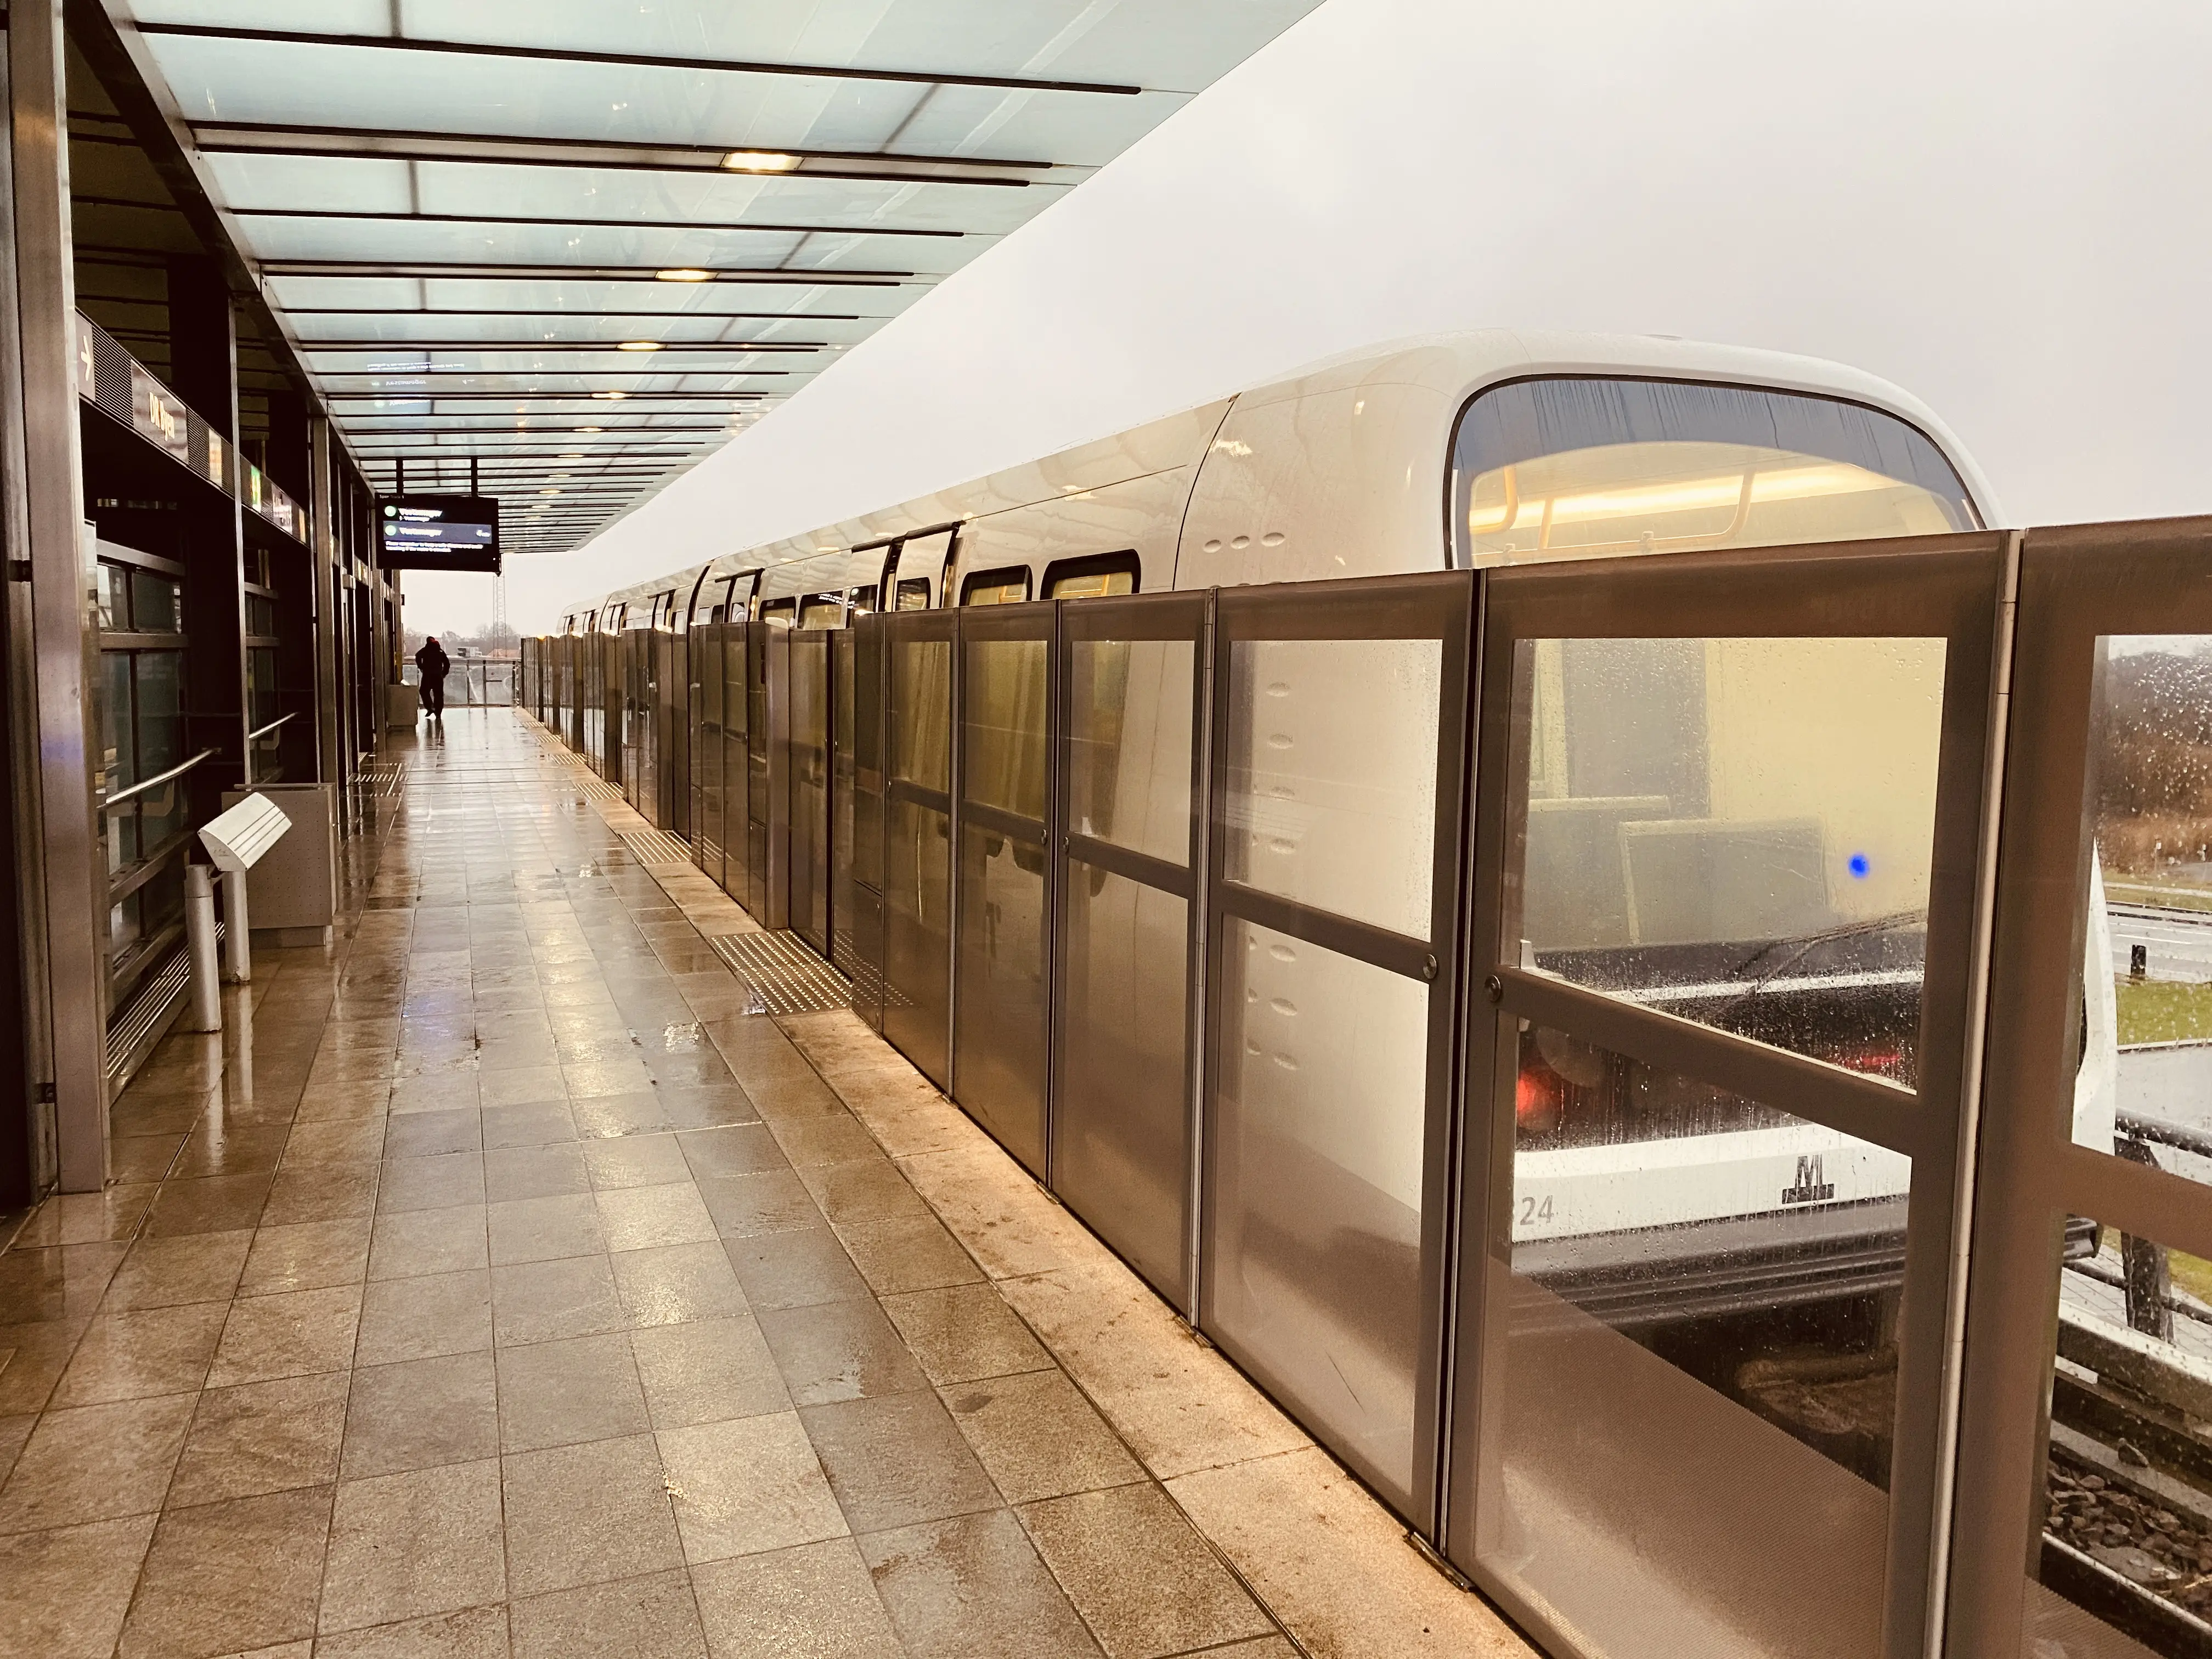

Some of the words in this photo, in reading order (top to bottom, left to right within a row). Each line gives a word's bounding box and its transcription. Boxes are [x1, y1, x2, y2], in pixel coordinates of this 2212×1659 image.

[149, 392, 160, 428] DR
[159, 399, 175, 442] Byen
[1520, 1195, 1554, 1225] 24
